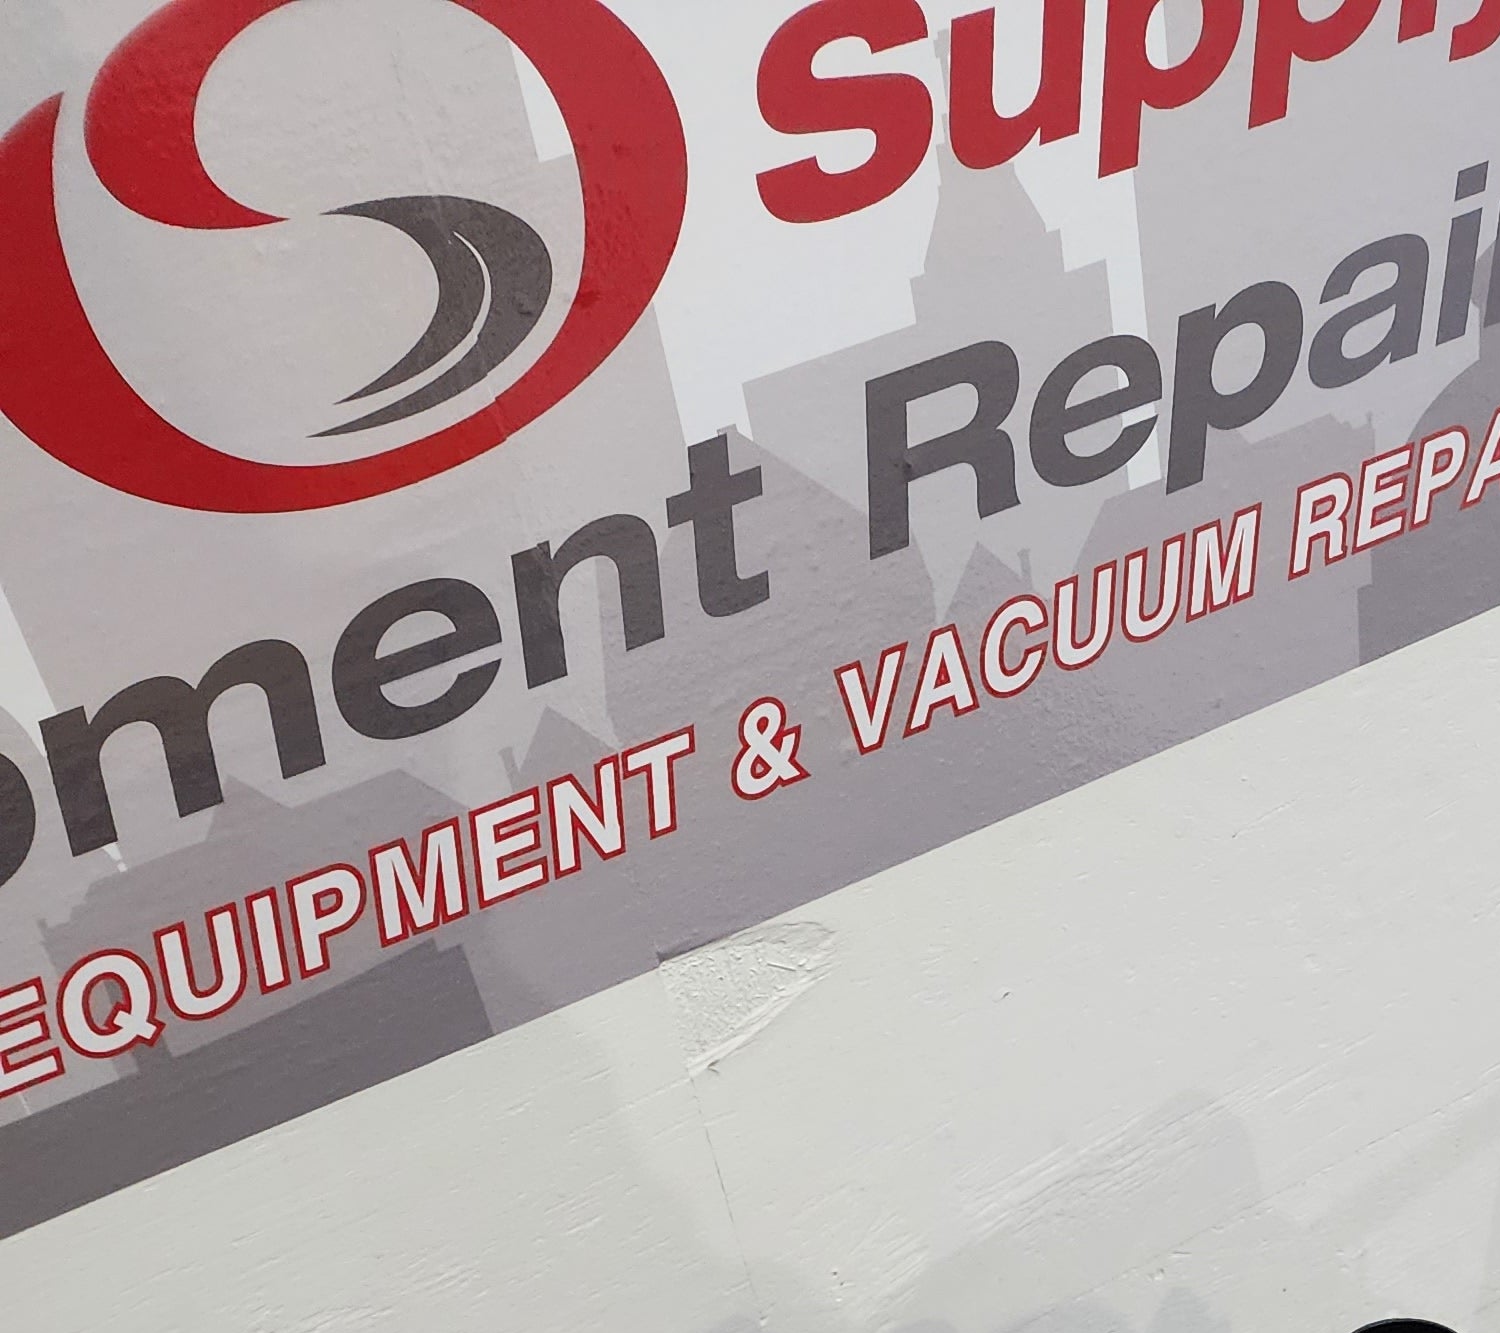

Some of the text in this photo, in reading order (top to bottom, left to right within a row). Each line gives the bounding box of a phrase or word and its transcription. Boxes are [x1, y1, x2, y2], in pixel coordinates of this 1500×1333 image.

[0, 724, 695, 1098] EQUIPMENT
[732, 696, 811, 800] &
[834, 502, 1263, 756] VACUUM
